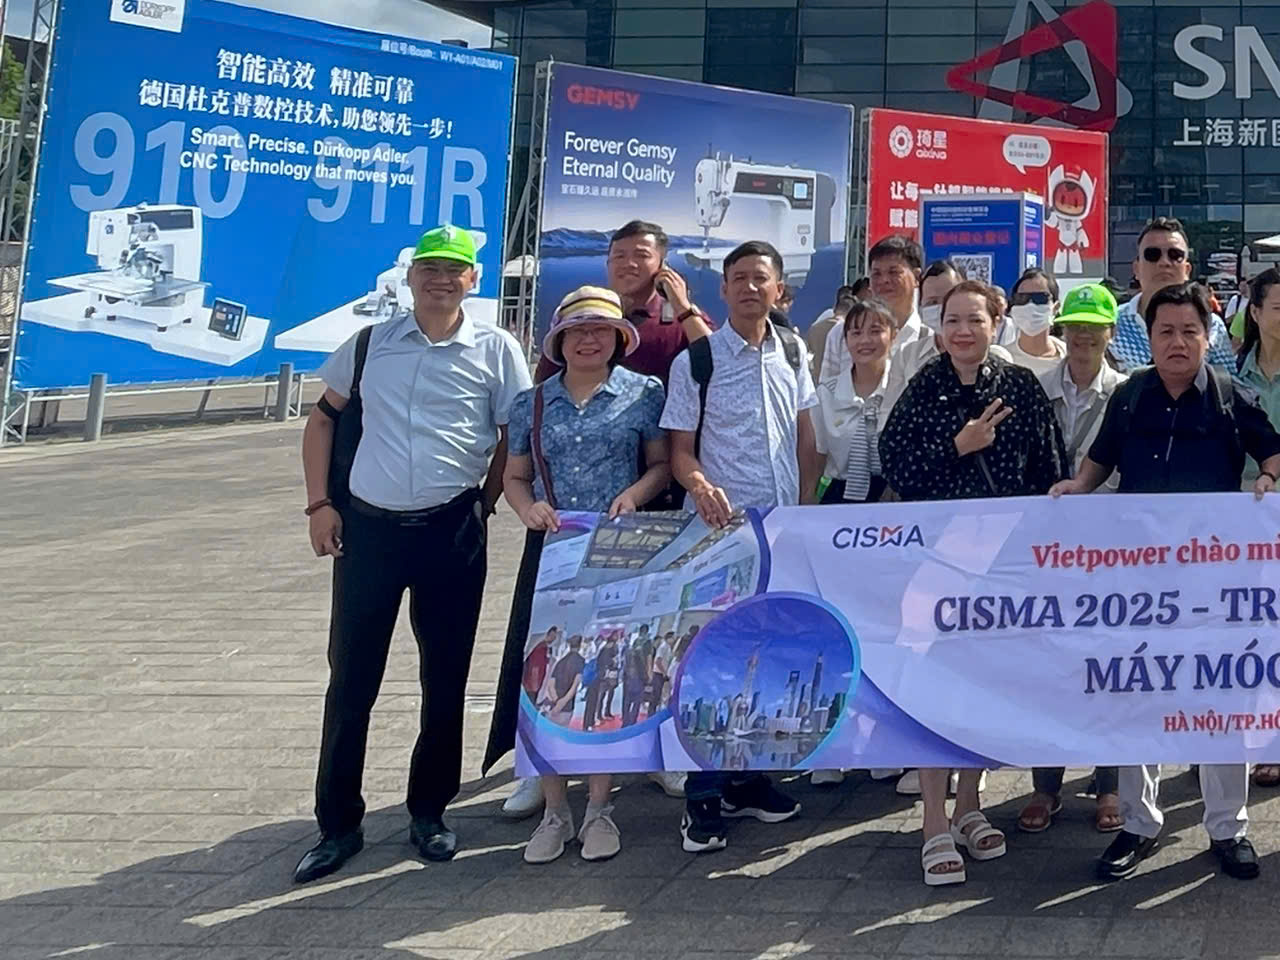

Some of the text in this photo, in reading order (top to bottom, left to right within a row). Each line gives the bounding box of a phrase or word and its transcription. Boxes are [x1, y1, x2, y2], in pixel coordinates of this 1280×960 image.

[216, 48, 415, 105] 智能高效 精准可靠
[567, 84, 640, 111] GEMSY
[190, 127, 410, 165] Smart. Precise. Dürkopp Adler.
[564, 130, 677, 165] Forever Gemsy
[69, 112, 248, 220] 910
[180, 151, 417, 186] CNC Technology that moves you.
[307, 136, 489, 228] 911R
[562, 155, 675, 188] Eternal Quality
[832, 524, 925, 549] CISMA
[1032, 542, 1170, 573] Vietpower
[1176, 535, 1240, 564] chào
[934, 594, 1065, 633] CISMA
[1074, 589, 1181, 628] 2025
[1084, 641, 1184, 694] MÁY
[1163, 709, 1189, 733] HÀ
